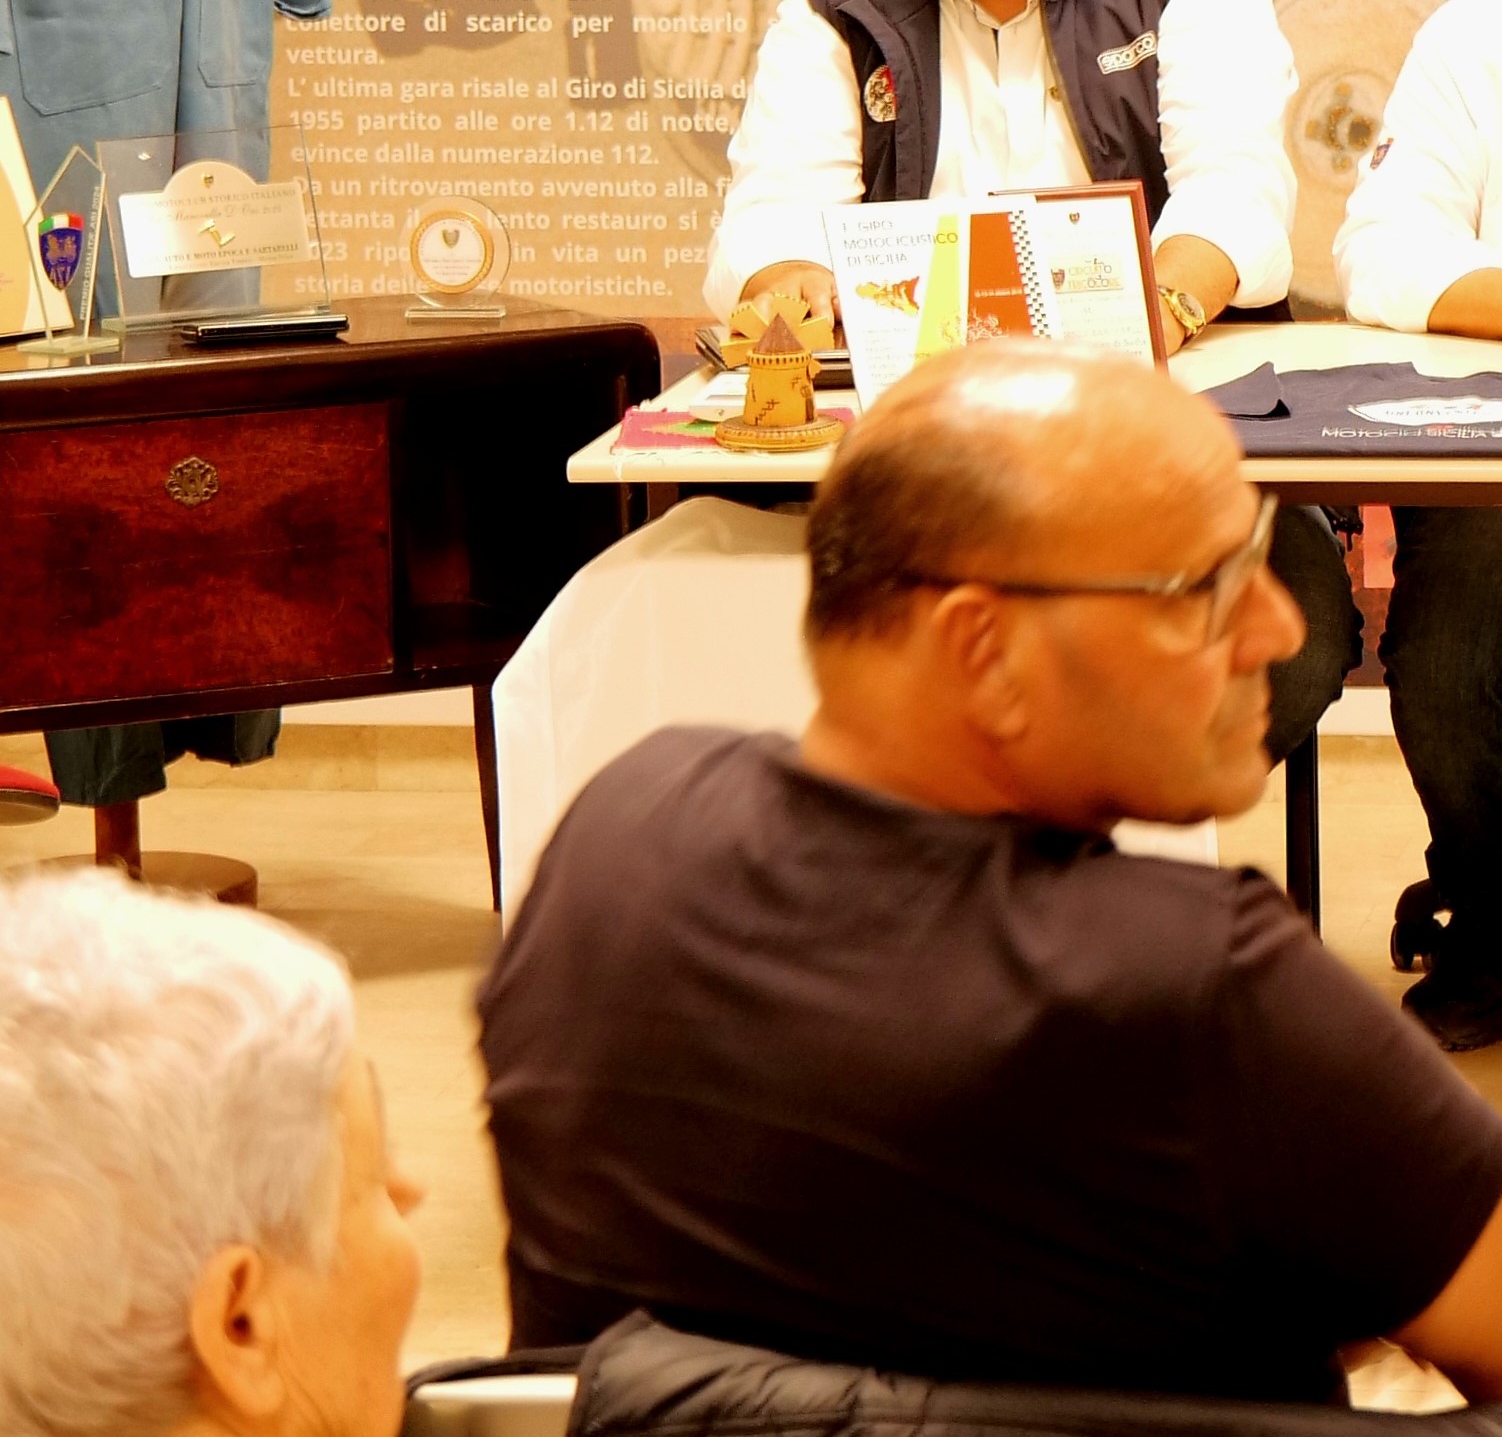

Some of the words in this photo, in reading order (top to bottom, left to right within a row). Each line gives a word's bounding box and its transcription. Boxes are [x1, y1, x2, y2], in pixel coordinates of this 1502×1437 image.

[465, 9, 552, 33] scarico
[632, 8, 748, 34] montarlo
[285, 45, 386, 66] vettura.
[312, 75, 393, 99] ultima
[399, 81, 455, 104] gara
[461, 76, 529, 99] risale
[564, 74, 617, 99] Giro
[651, 77, 724, 99] Sicilia
[289, 108, 344, 134] 1955
[356, 108, 442, 136] partito
[454, 109, 498, 132] alle
[510, 114, 552, 132] ore
[564, 109, 614, 132] 1.12
[290, 141, 368, 164] evince
[374, 141, 435, 164] dalla
[440, 139, 604, 165] numerazione
[610, 139, 659, 165] 112.
[368, 175, 534, 197] ritrovamento
[541, 178, 657, 198] avvenuto
[509, 274, 673, 297] motoristiche.
